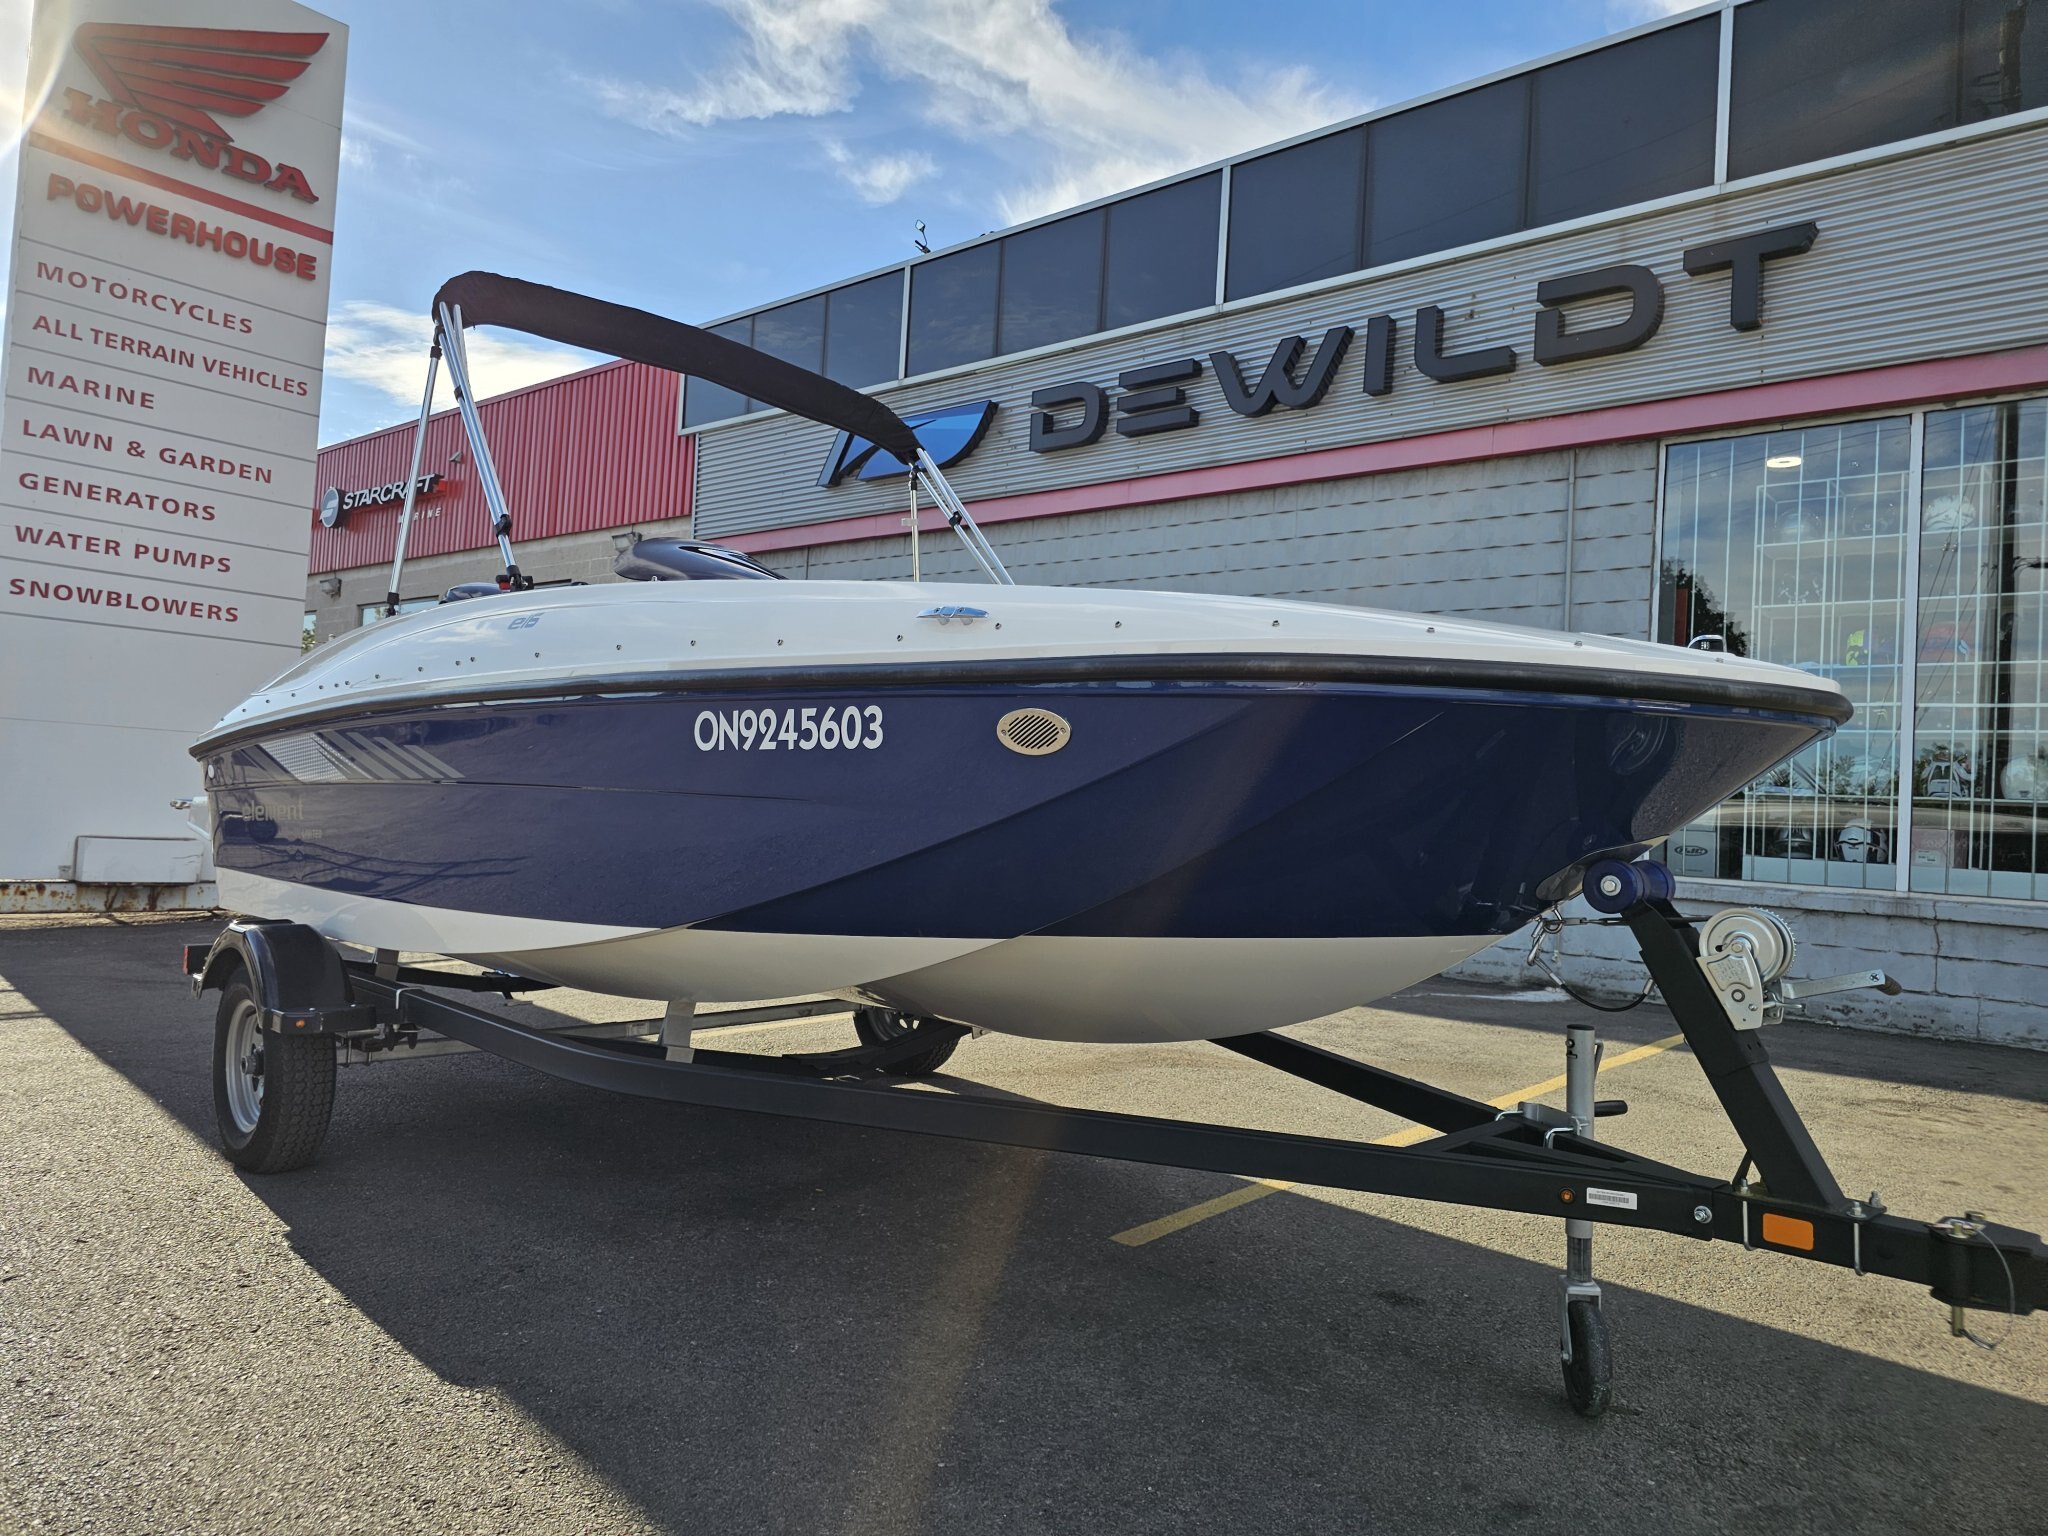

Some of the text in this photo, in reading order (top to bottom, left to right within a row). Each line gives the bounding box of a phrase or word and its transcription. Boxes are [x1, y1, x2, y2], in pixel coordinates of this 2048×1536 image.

[62, 86, 319, 204] HONDA
[47, 173, 317, 281] POWERHOUSE
[36, 262, 253, 334] MOTORCYCLES
[33, 315, 308, 397] ALL TERRAIN VEHICLES
[1029, 221, 1820, 453] DEWILDT
[27, 366, 155, 410] MARINE
[23, 419, 272, 484] LAWN & GARDEN
[18, 472, 216, 521] GENERATORS
[14, 525, 231, 573] WATER PUMPS
[9, 578, 239, 622] SNOWBLOWERS
[693, 704, 884, 752] ON9245603
